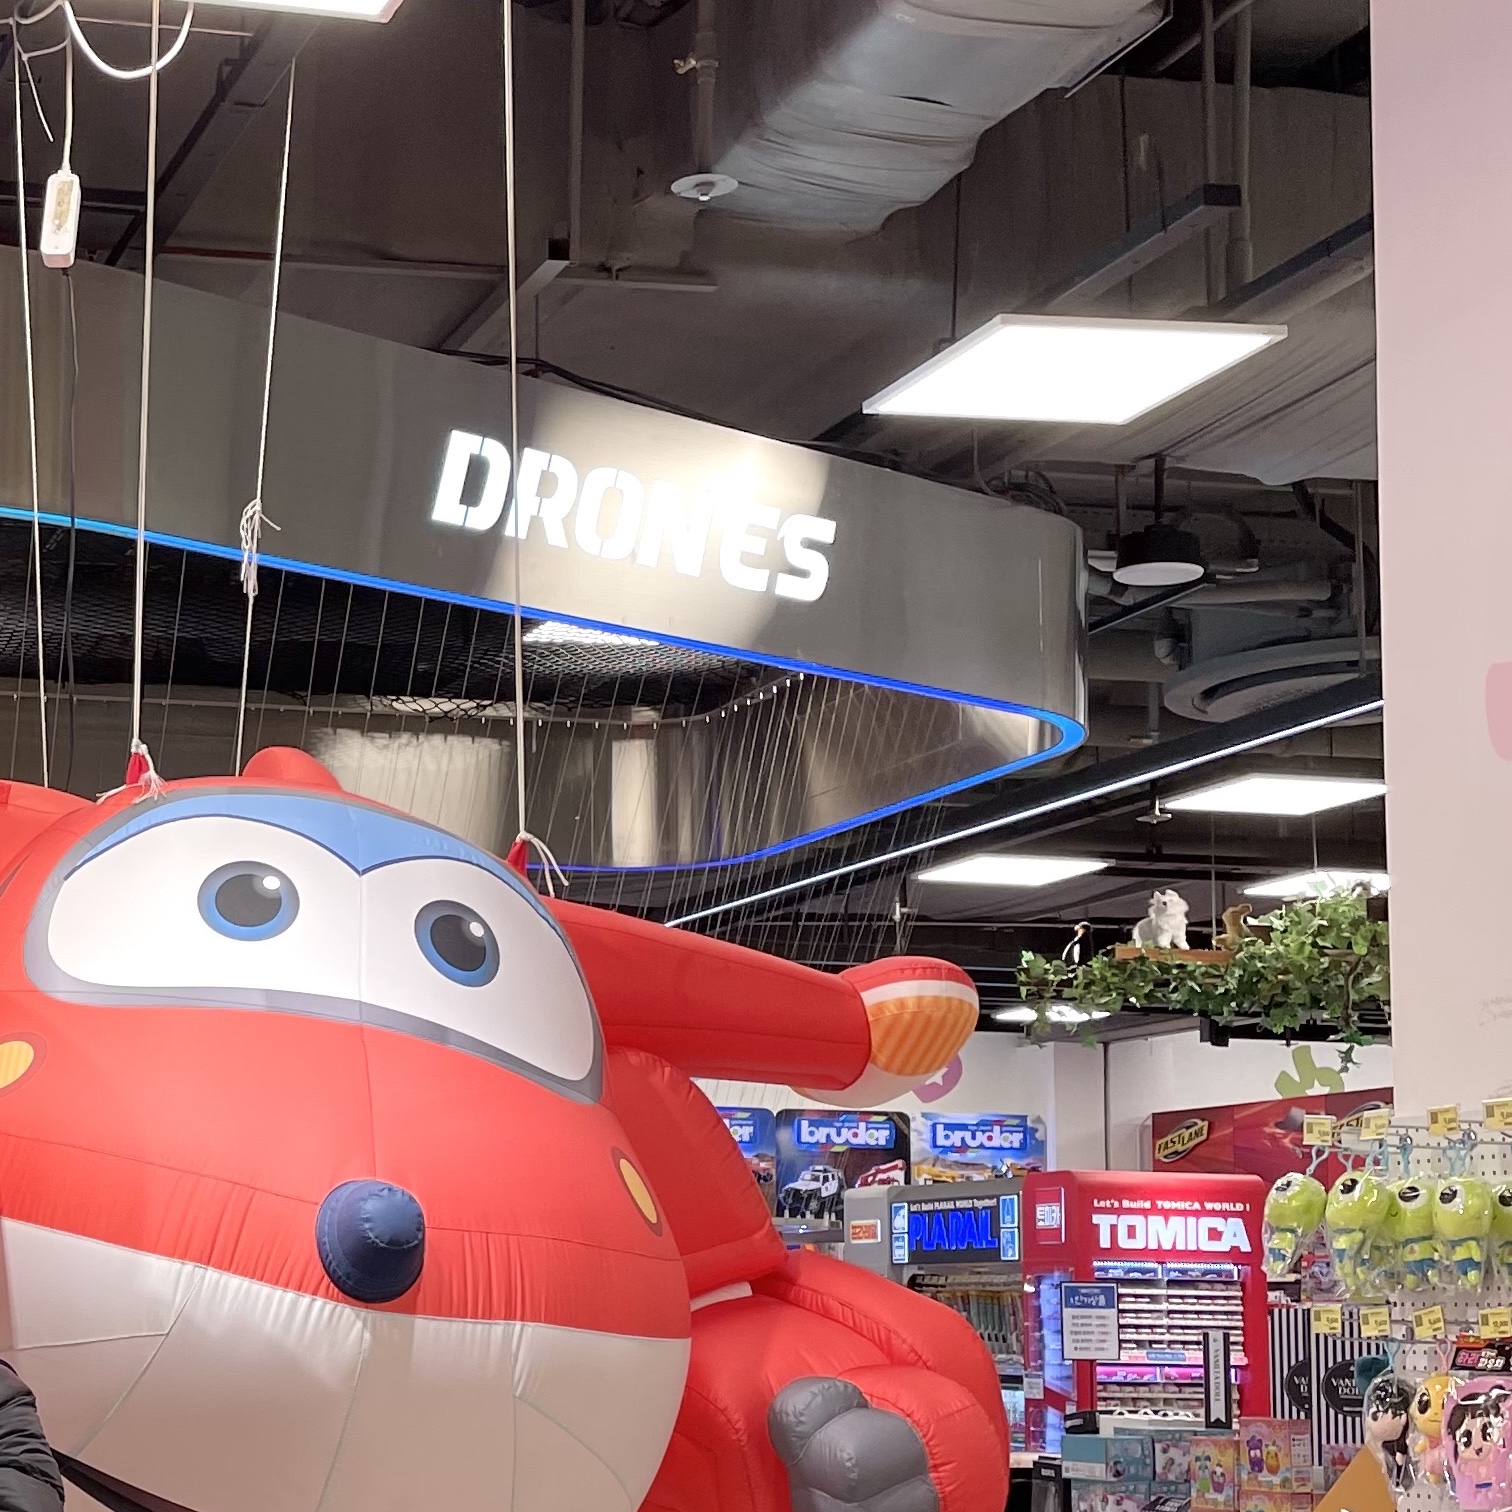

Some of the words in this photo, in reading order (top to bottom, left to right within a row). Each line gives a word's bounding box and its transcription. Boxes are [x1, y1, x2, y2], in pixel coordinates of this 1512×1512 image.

[431, 429, 837, 601] DRONES
[800, 1119, 891, 1147] bruder
[936, 1124, 1025, 1149] bruder
[1157, 1134, 1182, 1154] FAST
[1182, 1125, 1206, 1146] LANE
[1093, 1198, 1119, 1208] Let's
[1122, 1199, 1151, 1210] Build
[1156, 1200, 1201, 1210] TOMICA
[1204, 1201, 1243, 1211] WORLD
[910, 1209, 998, 1250] PLARAIL
[1091, 1213, 1252, 1253] TOMICA
